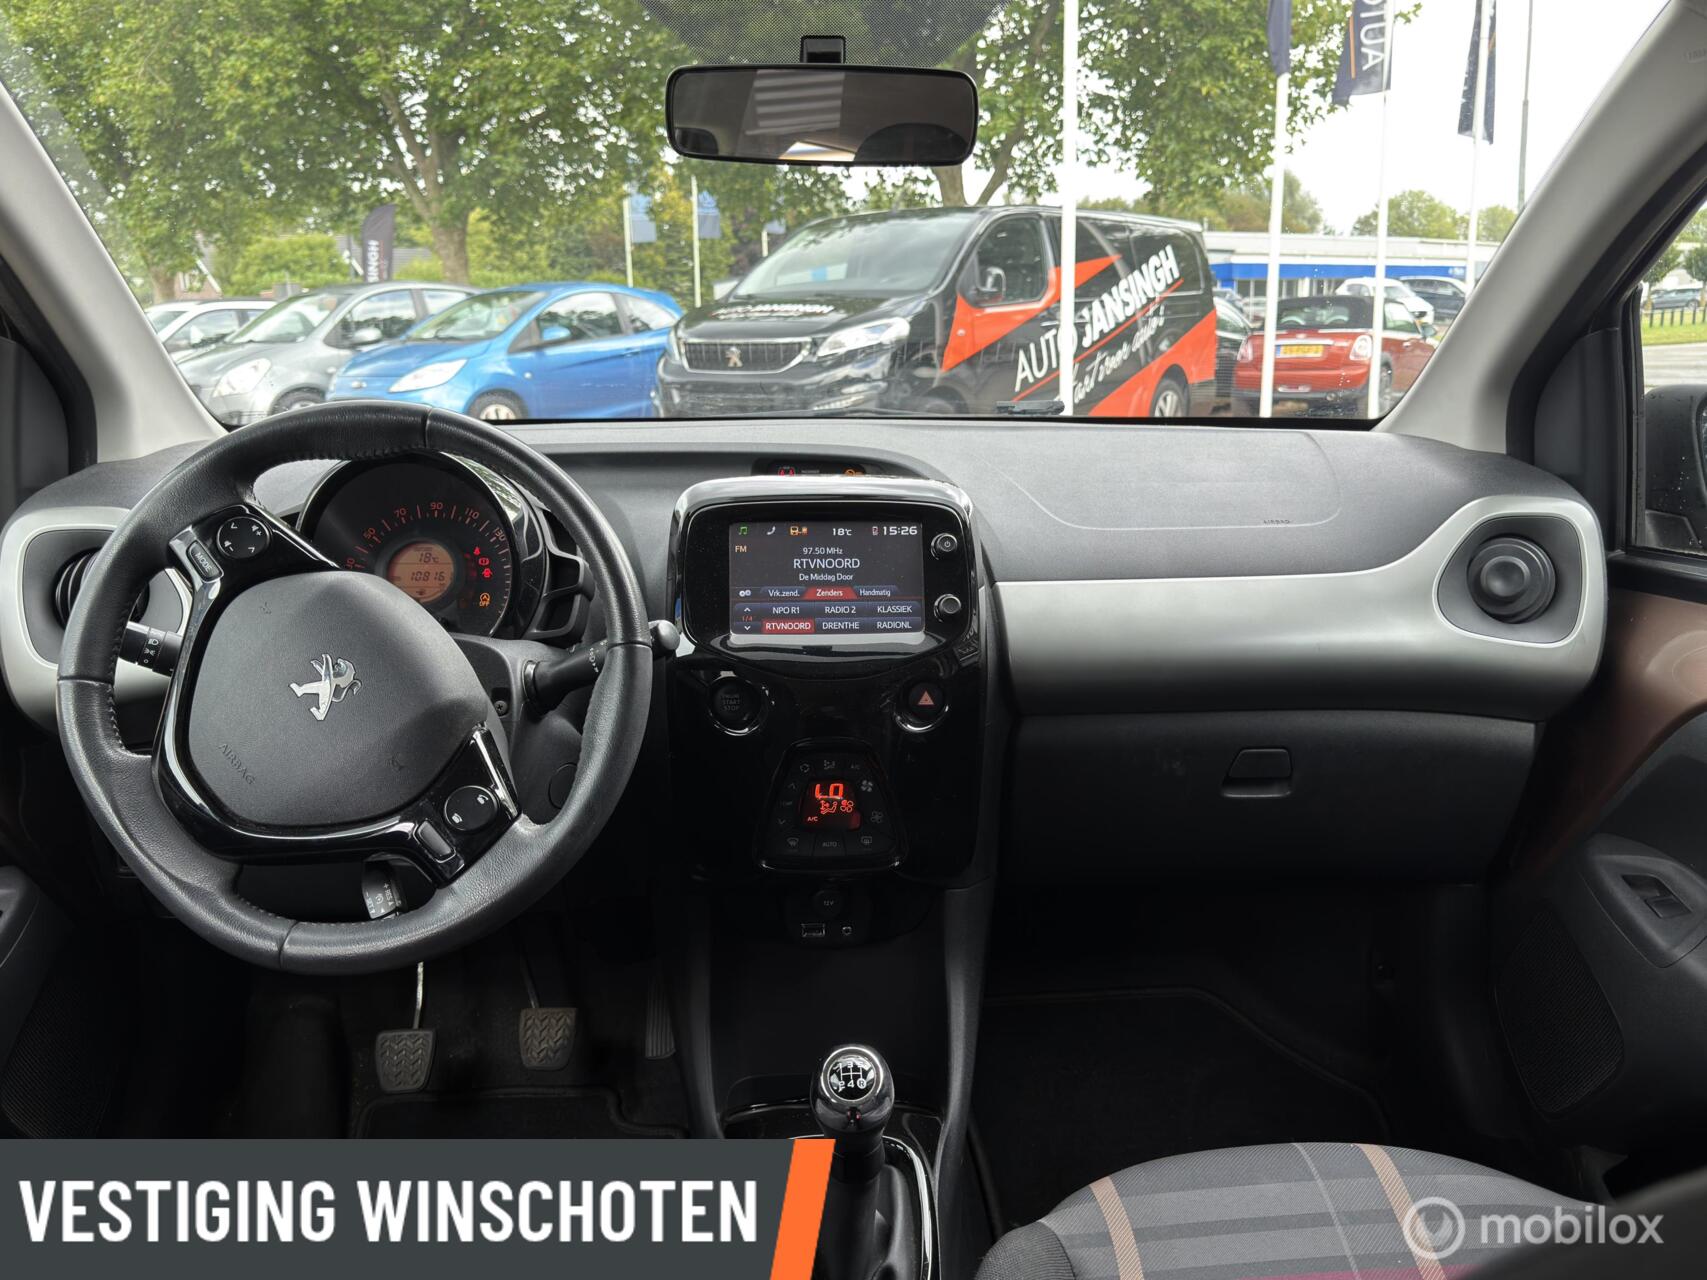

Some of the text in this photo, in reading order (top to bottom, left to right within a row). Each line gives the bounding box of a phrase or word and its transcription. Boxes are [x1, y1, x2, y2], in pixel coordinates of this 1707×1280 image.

[1082, 244, 1180, 347] JANSINGH
[430, 502, 443, 510] 90
[394, 507, 407, 518] 70
[465, 507, 480, 520] 110
[363, 527, 376, 540] 50
[493, 527, 506, 542] 130
[883, 526, 918, 536] 15:26
[735, 545, 747, 553] FM
[803, 547, 843, 555] 97.50 MHz
[195, 552, 213, 573] MODE
[793, 558, 861, 569] RTVNOORD
[411, 571, 445, 582] 10816
[799, 573, 854, 583] De Middag Door
[816, 588, 843, 597] Zenders
[859, 588, 891, 597] Handmatig
[772, 606, 800, 614] NPO R1
[825, 606, 857, 614] RADIO 2
[877, 605, 912, 614] KLASSIEK
[765, 622, 811, 631] RTVNOORD
[822, 621, 860, 630] DRENTHE
[877, 621, 912, 630] RADIONL
[217, 744, 256, 785] AIRBAG
[847, 1080, 855, 1088] 4
